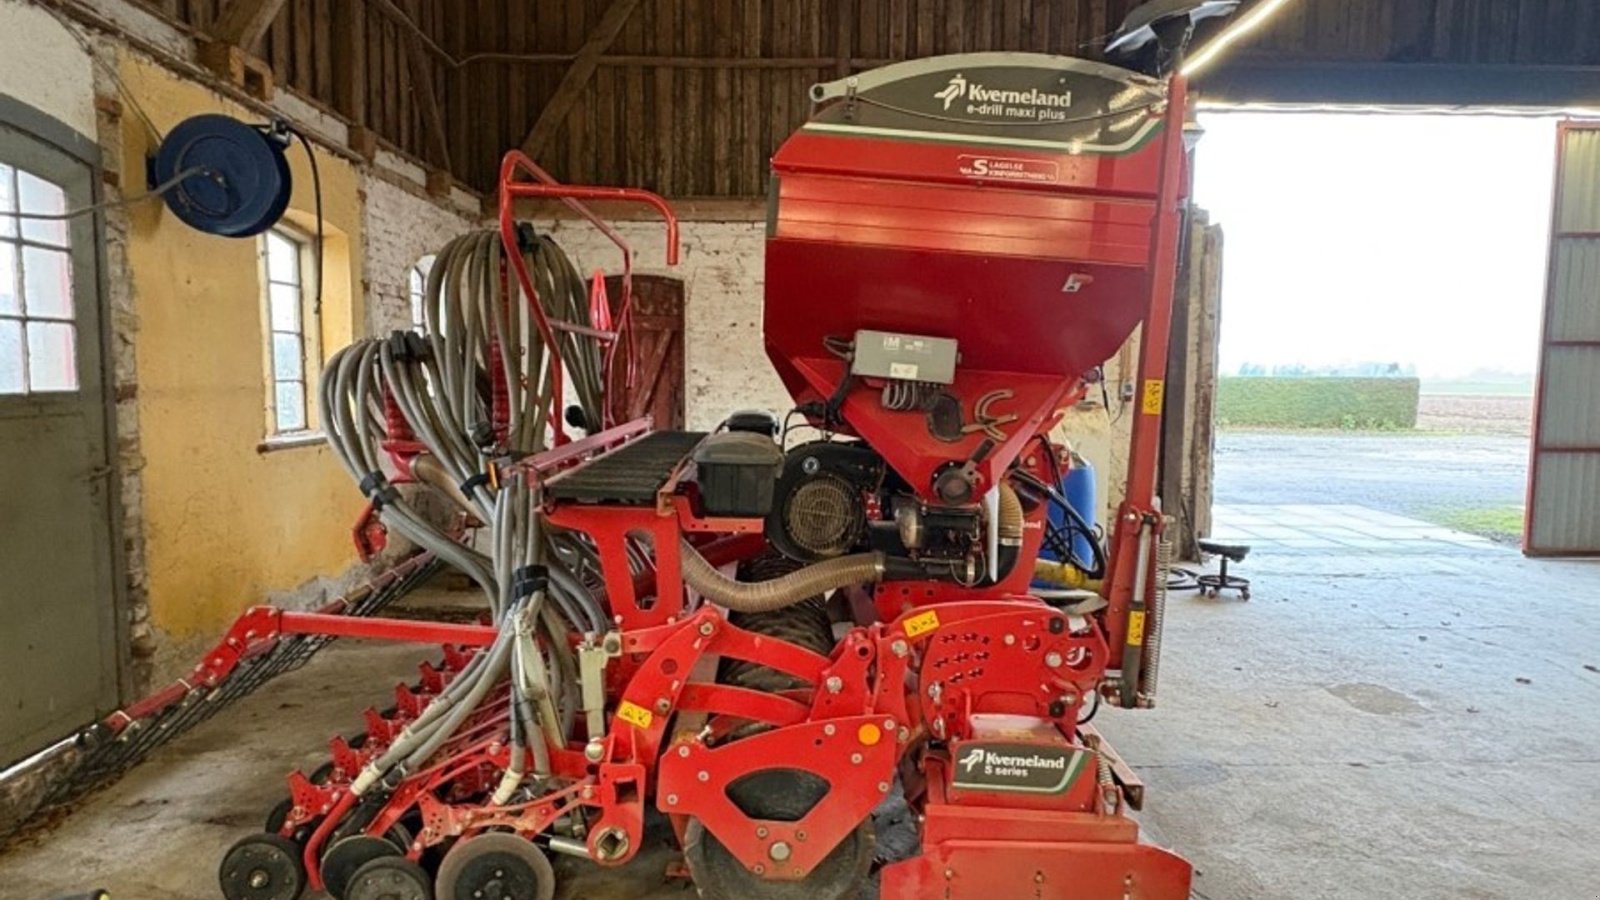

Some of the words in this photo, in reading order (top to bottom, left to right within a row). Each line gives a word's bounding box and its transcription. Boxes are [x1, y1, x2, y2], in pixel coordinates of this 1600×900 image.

[968, 84, 1071, 107] Kverneland
[967, 104, 1003, 116] e-drill
[1005, 106, 1036, 118] maxi
[1038, 108, 1066, 121] plus
[985, 752, 1065, 769] Kverneland
[984, 764, 993, 775] S
[995, 766, 1029, 777] series
